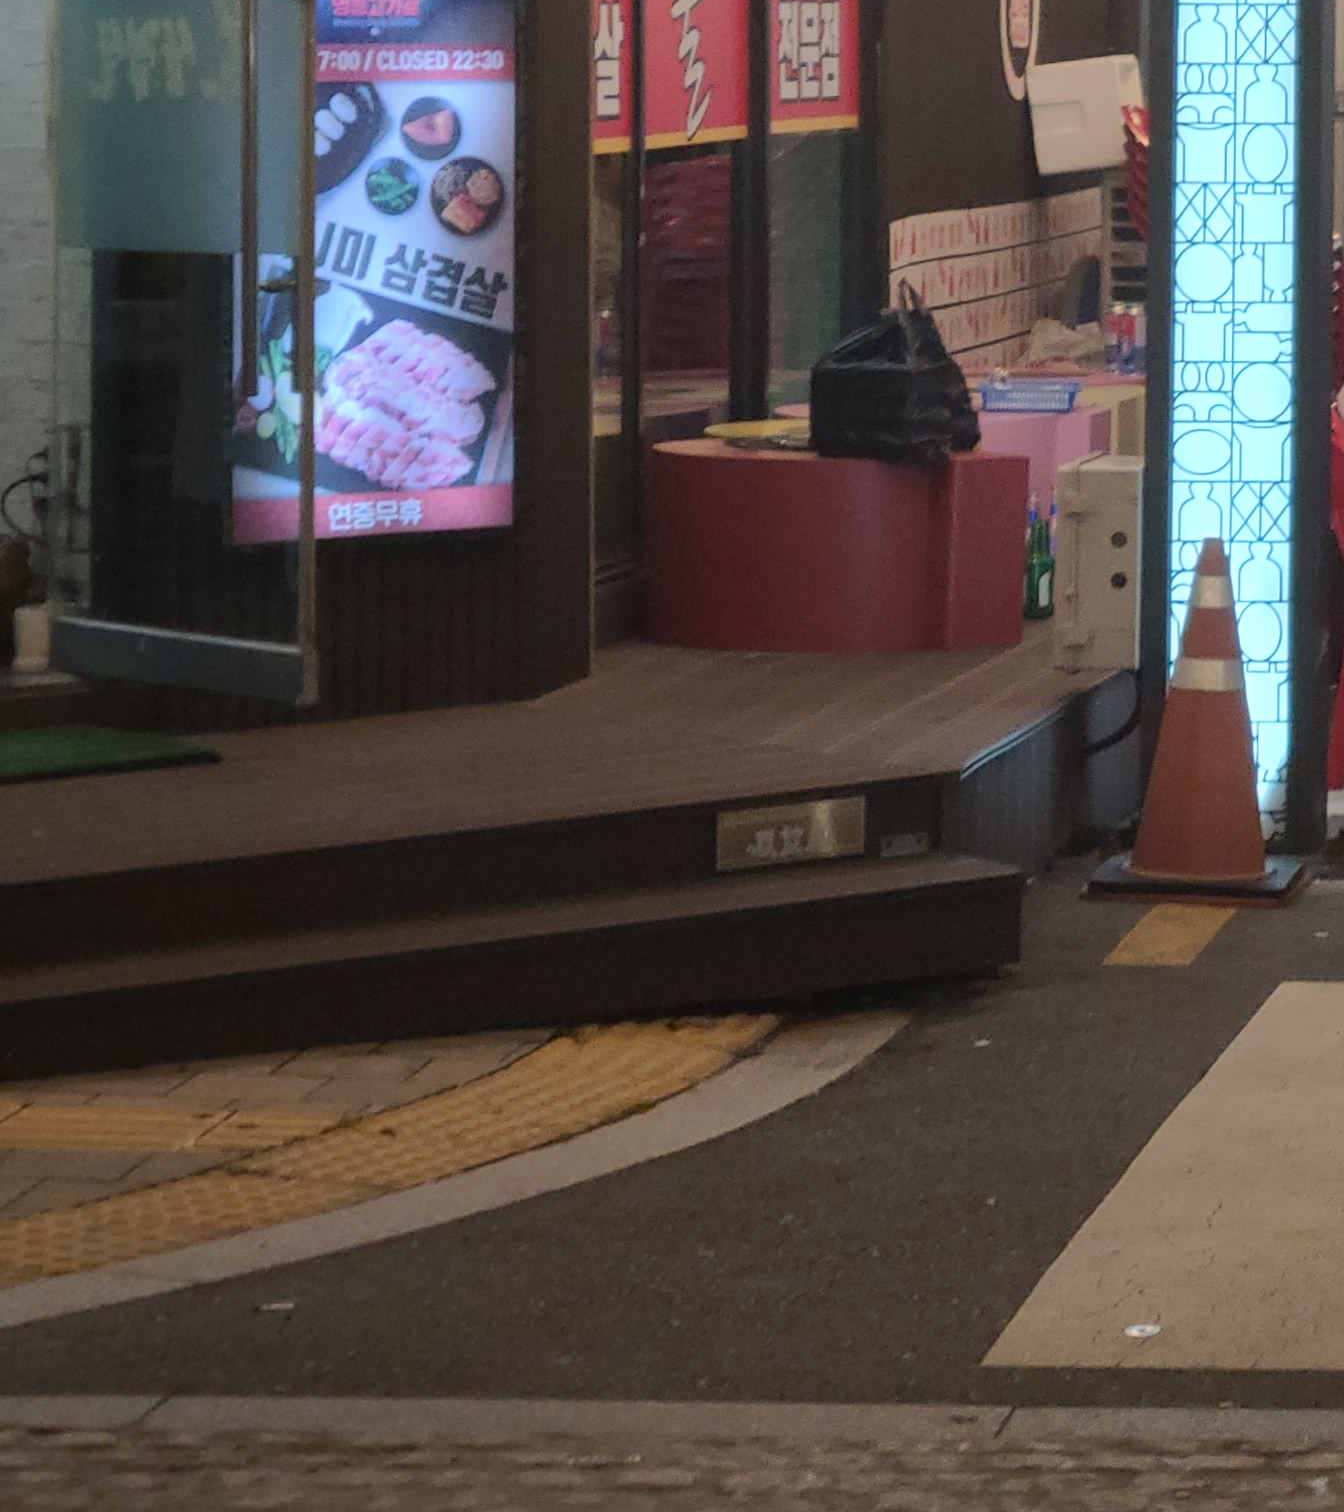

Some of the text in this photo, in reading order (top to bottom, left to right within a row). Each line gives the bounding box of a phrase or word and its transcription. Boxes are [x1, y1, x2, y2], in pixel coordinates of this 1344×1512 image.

[376, 49, 449, 72] CLOSED
[452, 49, 505, 72] 22:30
[380, 243, 510, 320] 삼겹살
[326, 495, 424, 531] 연중무휴
